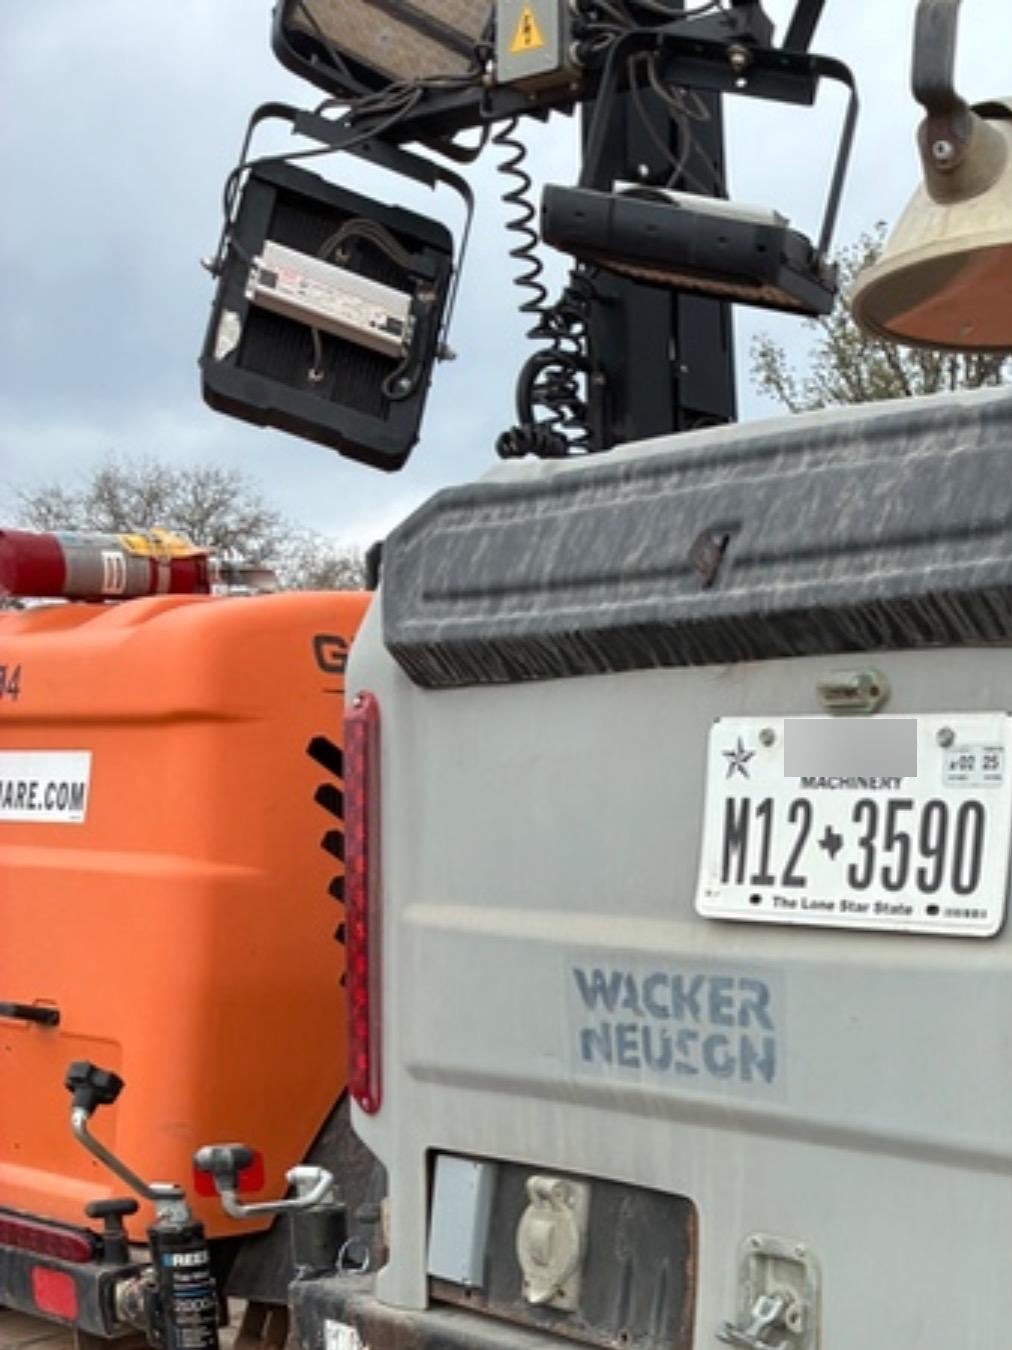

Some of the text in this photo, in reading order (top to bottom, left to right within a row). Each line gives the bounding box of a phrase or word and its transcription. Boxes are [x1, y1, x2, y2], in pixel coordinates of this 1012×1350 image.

[313, 632, 353, 674] G
[0, 779, 85, 811] ARE.COM
[847, 797, 987, 896] 3590
[773, 896, 913, 916] The Lone Star State
[573, 967, 774, 1031] WACKER
